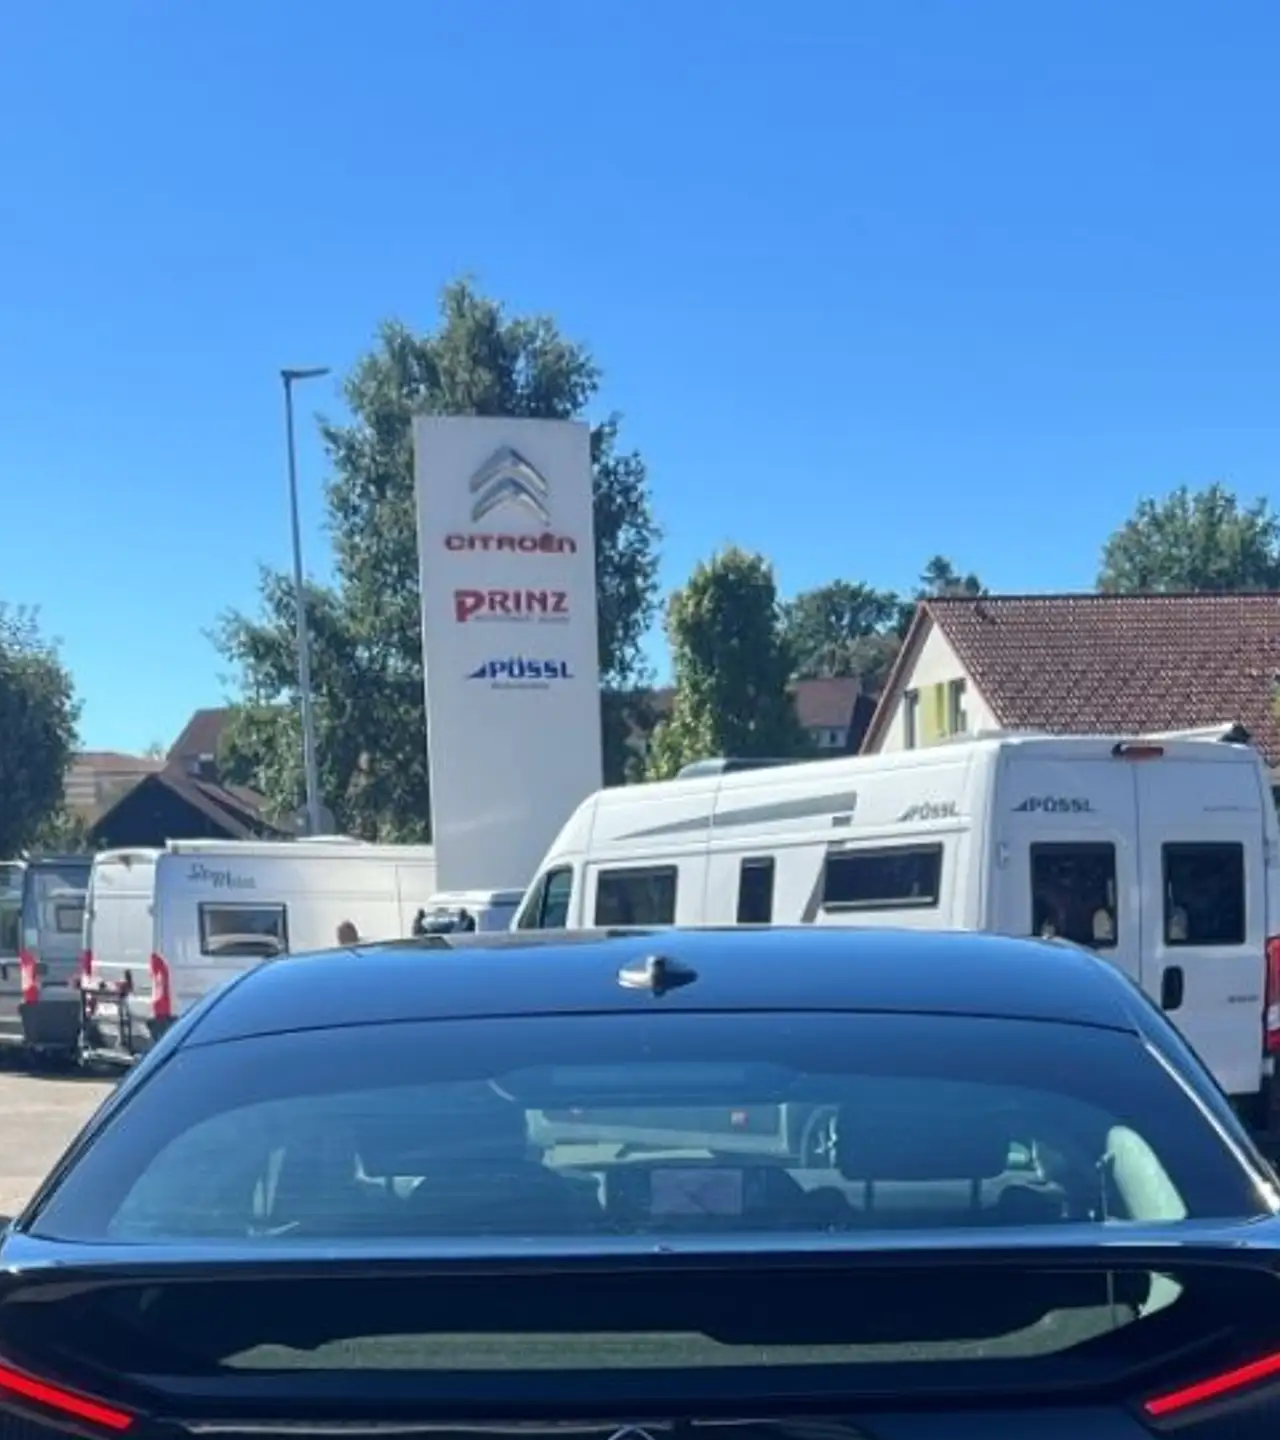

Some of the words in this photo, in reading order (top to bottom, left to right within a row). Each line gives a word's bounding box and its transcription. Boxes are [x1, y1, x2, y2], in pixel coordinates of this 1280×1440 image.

[444, 532, 577, 554] CITROËN
[454, 588, 569, 623] PRINZ
[488, 656, 575, 679] PÖSSL
